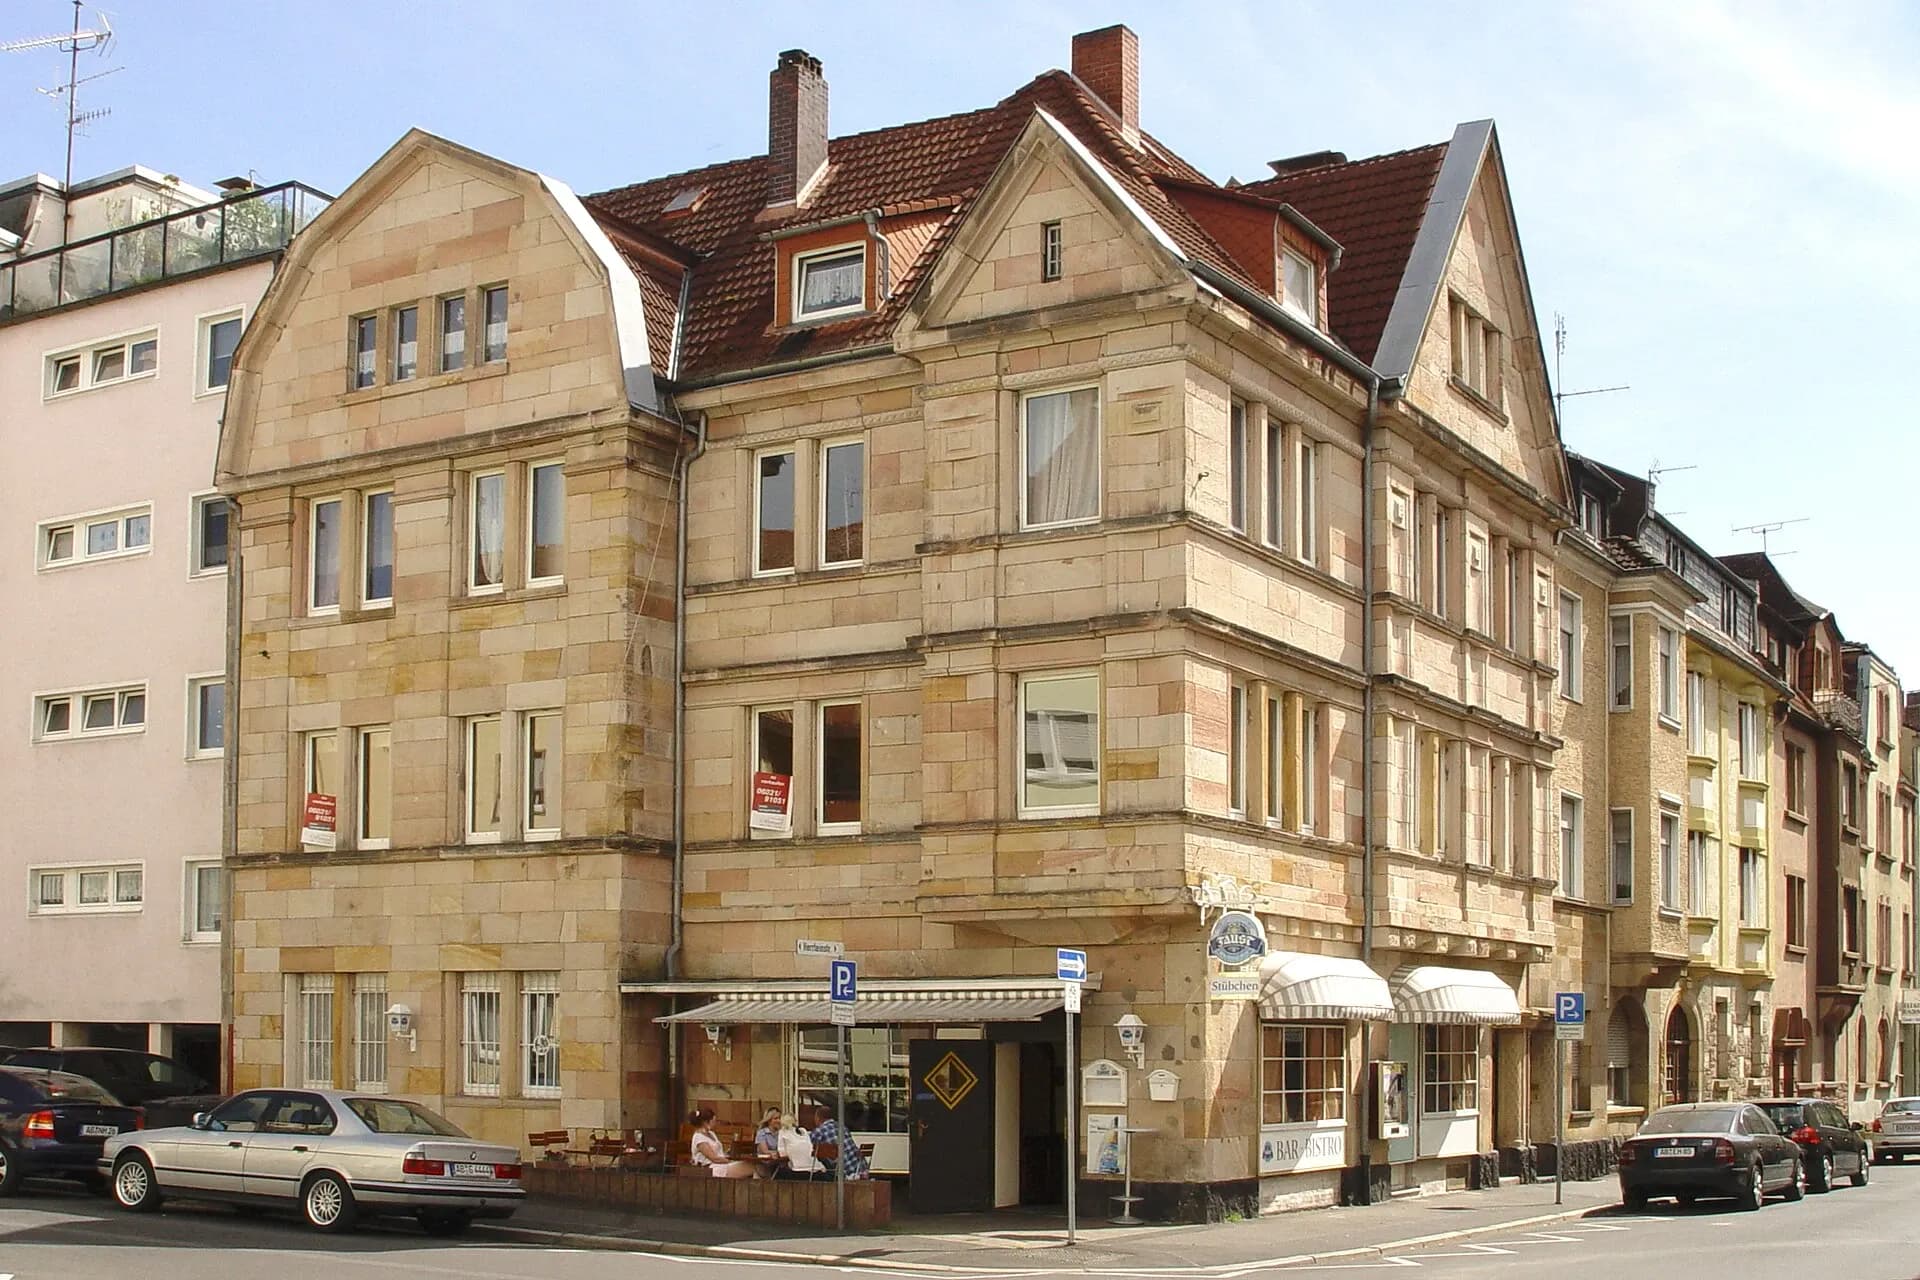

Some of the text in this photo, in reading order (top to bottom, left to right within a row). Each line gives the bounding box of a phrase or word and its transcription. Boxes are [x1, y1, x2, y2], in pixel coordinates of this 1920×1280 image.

[836, 965, 851, 996] P
[1211, 981, 1259, 992] Stübchen
[1560, 996, 1576, 1019] P
[1276, 1136, 1342, 1161] BAR BISTRO
